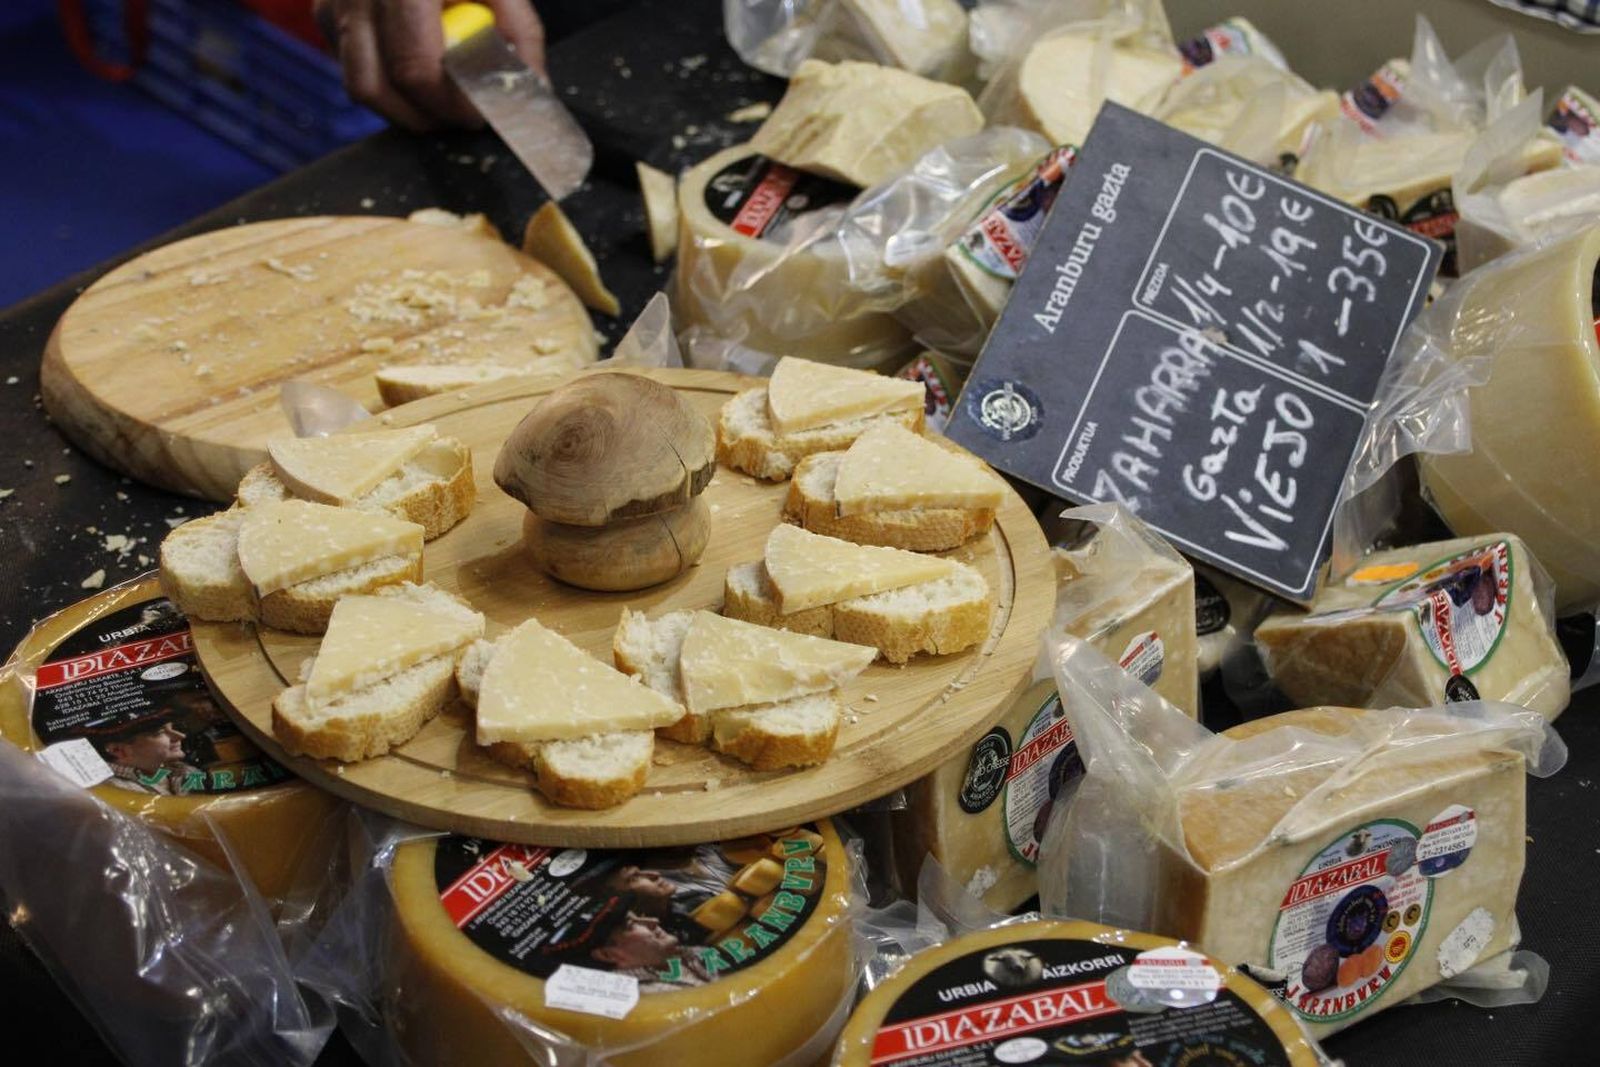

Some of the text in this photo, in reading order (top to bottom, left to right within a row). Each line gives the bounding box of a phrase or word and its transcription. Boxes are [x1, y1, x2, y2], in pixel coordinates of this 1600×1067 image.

[1033, 162, 1132, 336] Aranburu gazta
[1061, 421, 1099, 483] PRODUKTUA
[1290, 857, 1384, 903] IDIAZABAL
[938, 979, 999, 1002] URBIA
[1041, 952, 1126, 981] AIZKORRI
[902, 990, 1104, 1051] IDIAZABAL
